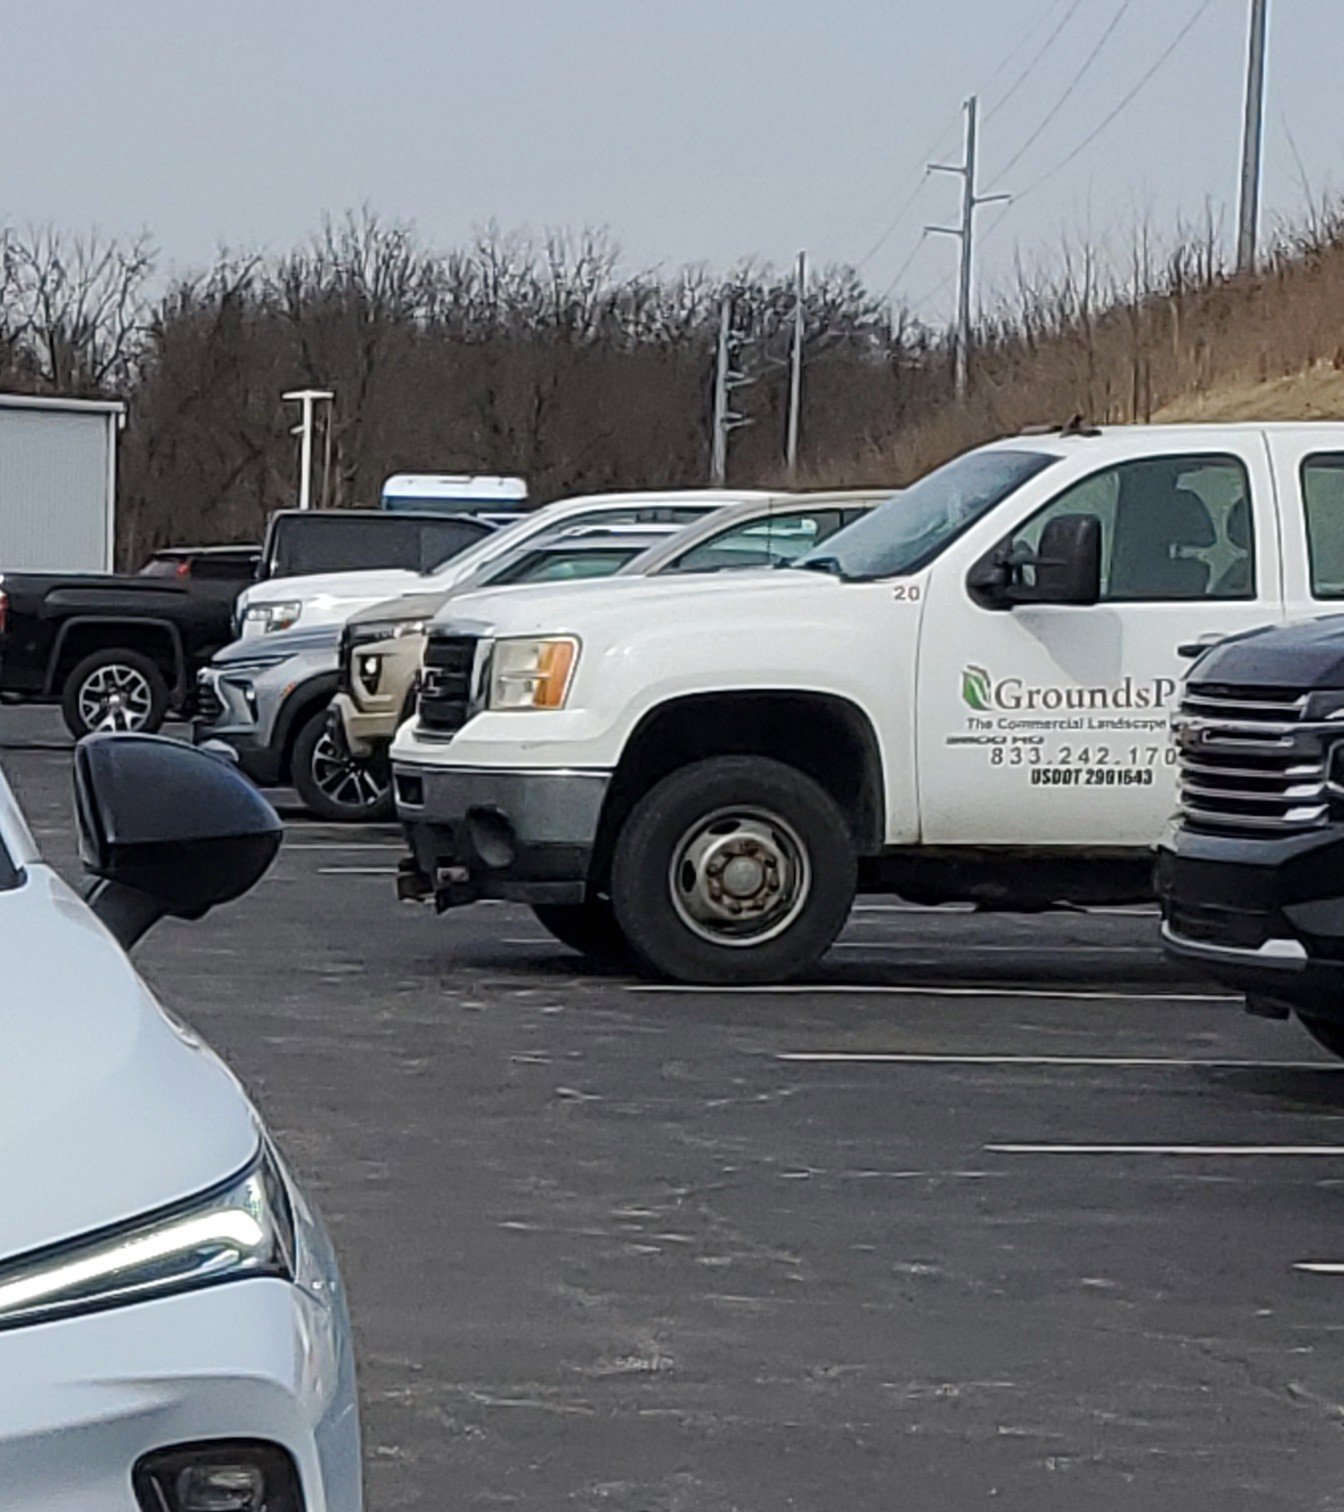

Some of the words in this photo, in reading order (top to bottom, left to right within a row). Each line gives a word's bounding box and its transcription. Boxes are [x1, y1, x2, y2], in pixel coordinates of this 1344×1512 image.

[893, 585, 921, 602] 20
[994, 676, 1177, 710] GroundsP
[966, 717, 993, 730] The
[997, 717, 1083, 730] Commercial
[1087, 717, 1167, 733] Landscape
[990, 746, 1177, 766] 833.242.170
[1030, 768, 1083, 786] USDOT
